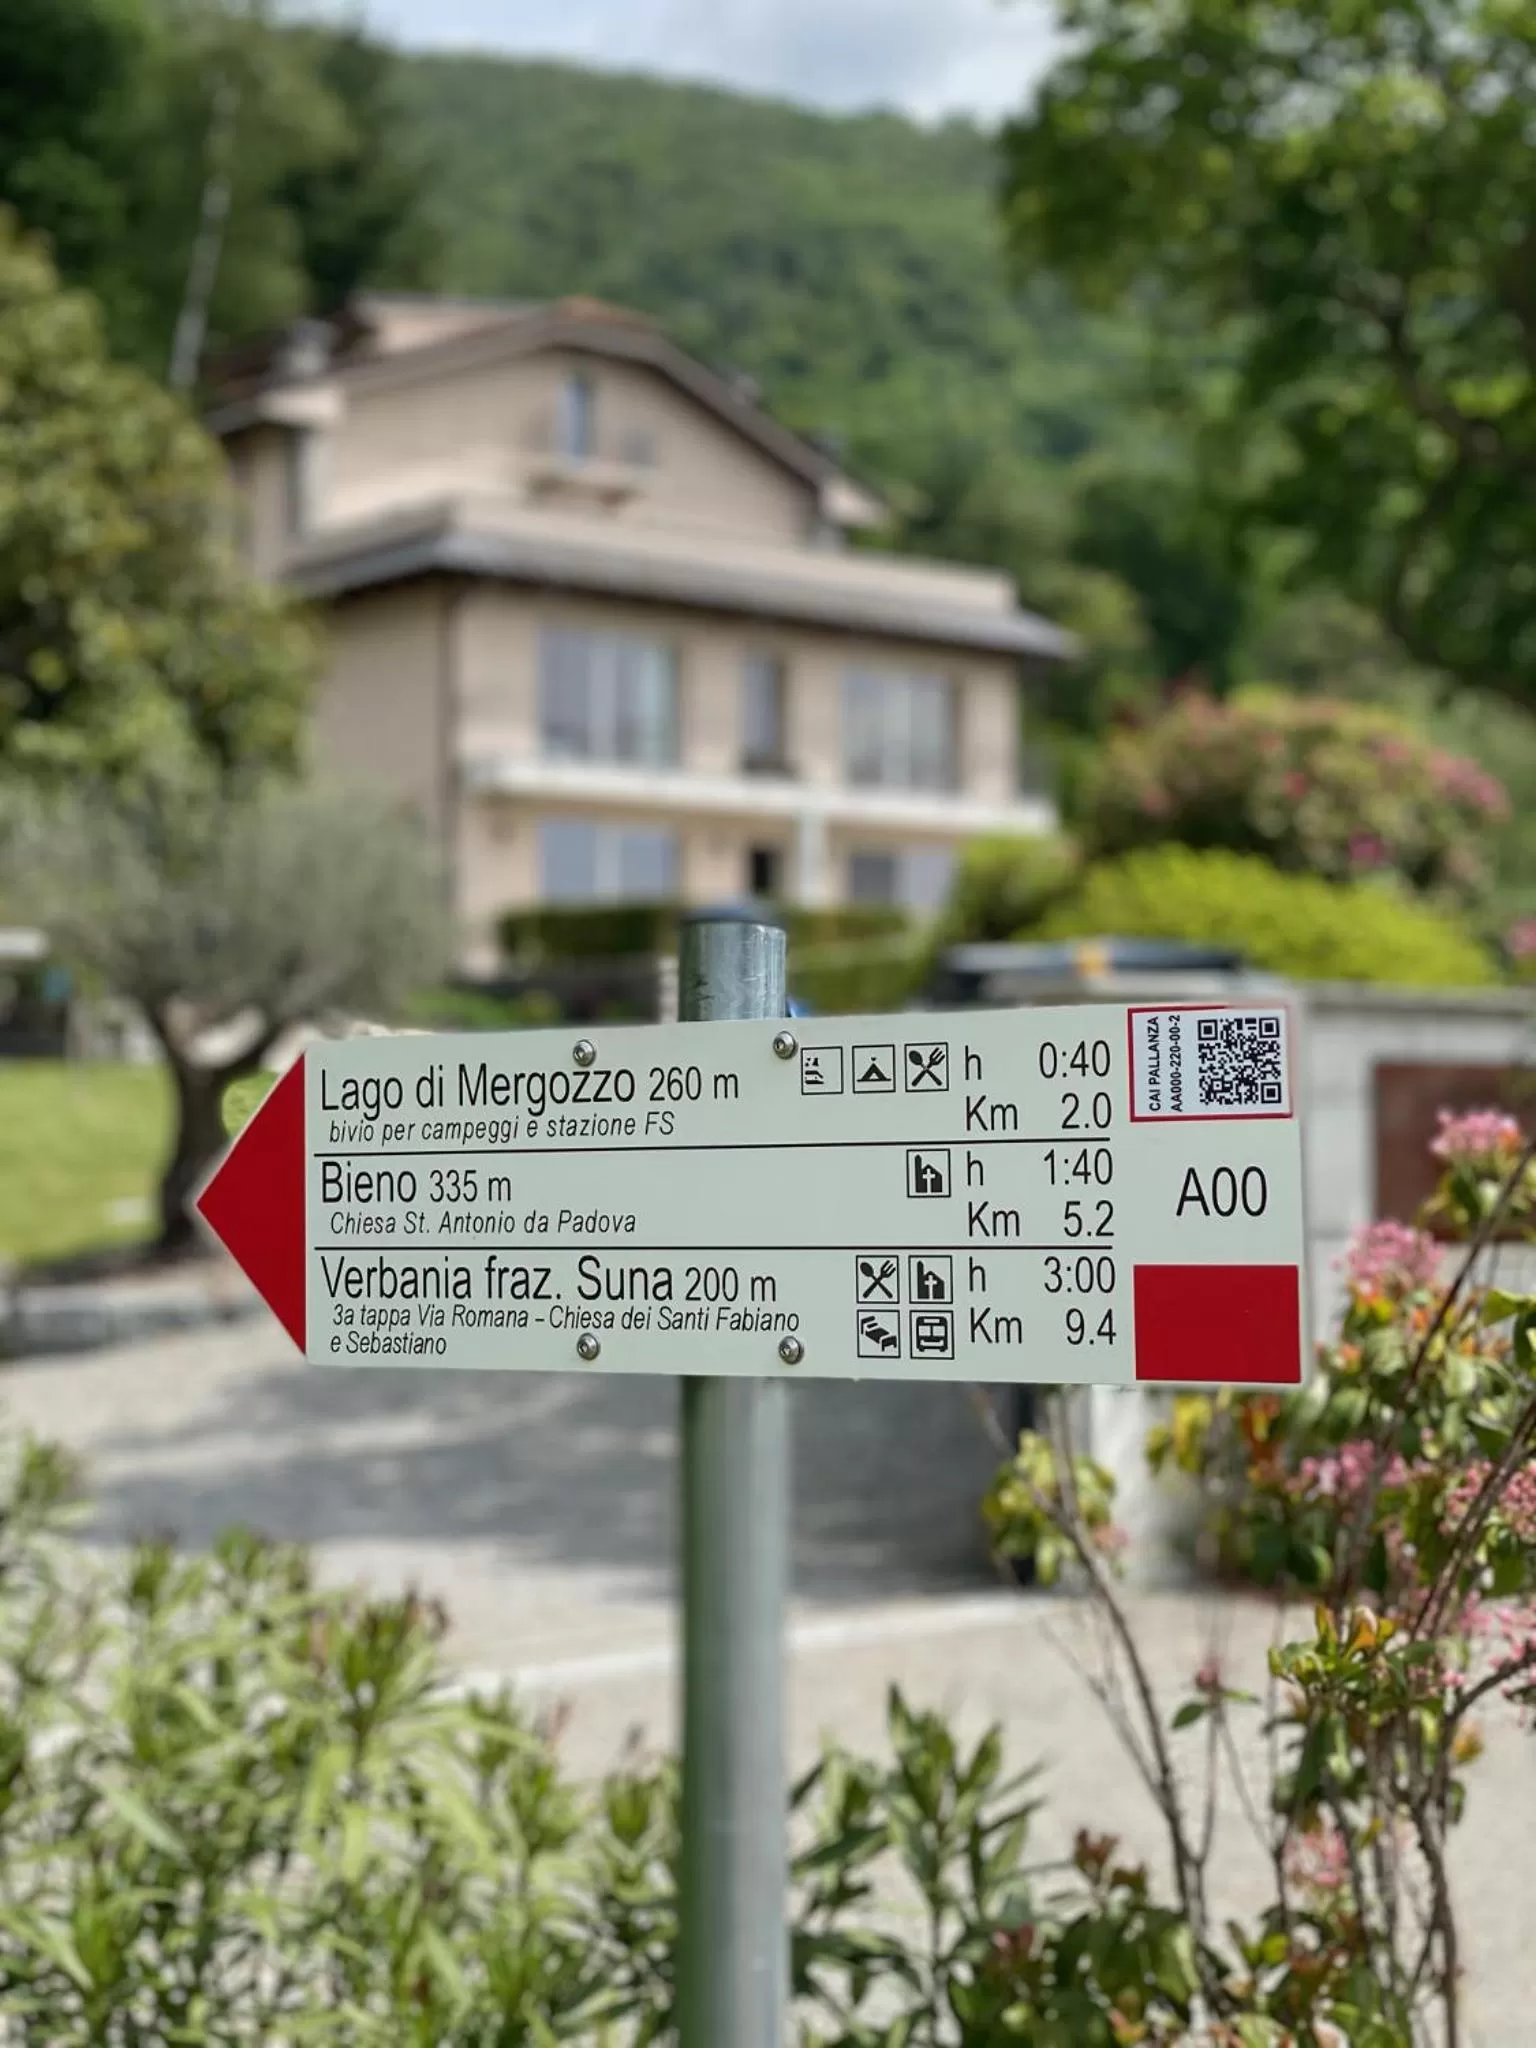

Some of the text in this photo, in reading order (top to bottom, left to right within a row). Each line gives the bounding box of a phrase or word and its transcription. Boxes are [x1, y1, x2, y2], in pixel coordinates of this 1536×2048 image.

[965, 1040, 1111, 1080] h 0:40
[1147, 1016, 1161, 1111] CAI PALLANZA
[1168, 1015, 1182, 1112] AA000-220-00-2
[322, 1063, 738, 1121] Lago di Mergozzo 260 m
[966, 1091, 1112, 1131] Km 2.0
[329, 1111, 675, 1146] bivio per campeggi e stazione FS
[322, 1160, 511, 1203] Bieno 335 m
[967, 1148, 1113, 1186] h 1:40
[1176, 1166, 1269, 1218] A00
[330, 1209, 636, 1235] Chiesa St. Antonio da Padova
[968, 1200, 1115, 1237] Km 5.2
[321, 1254, 776, 1302] Verbania fraz. Suna 200 m
[969, 1256, 1116, 1293] h 3:00
[332, 1304, 354, 1326] 3a
[360, 1304, 411, 1332] tappa
[418, 1304, 445, 1327] Via
[452, 1304, 529, 1328] Romana
[549, 1305, 615, 1330] Chiesa
[621, 1306, 652, 1330] dei
[657, 1306, 710, 1331] Santi
[716, 1307, 799, 1332] Fabiano
[970, 1307, 1116, 1345] Km 9.4
[330, 1331, 447, 1355] e Sebastiano
